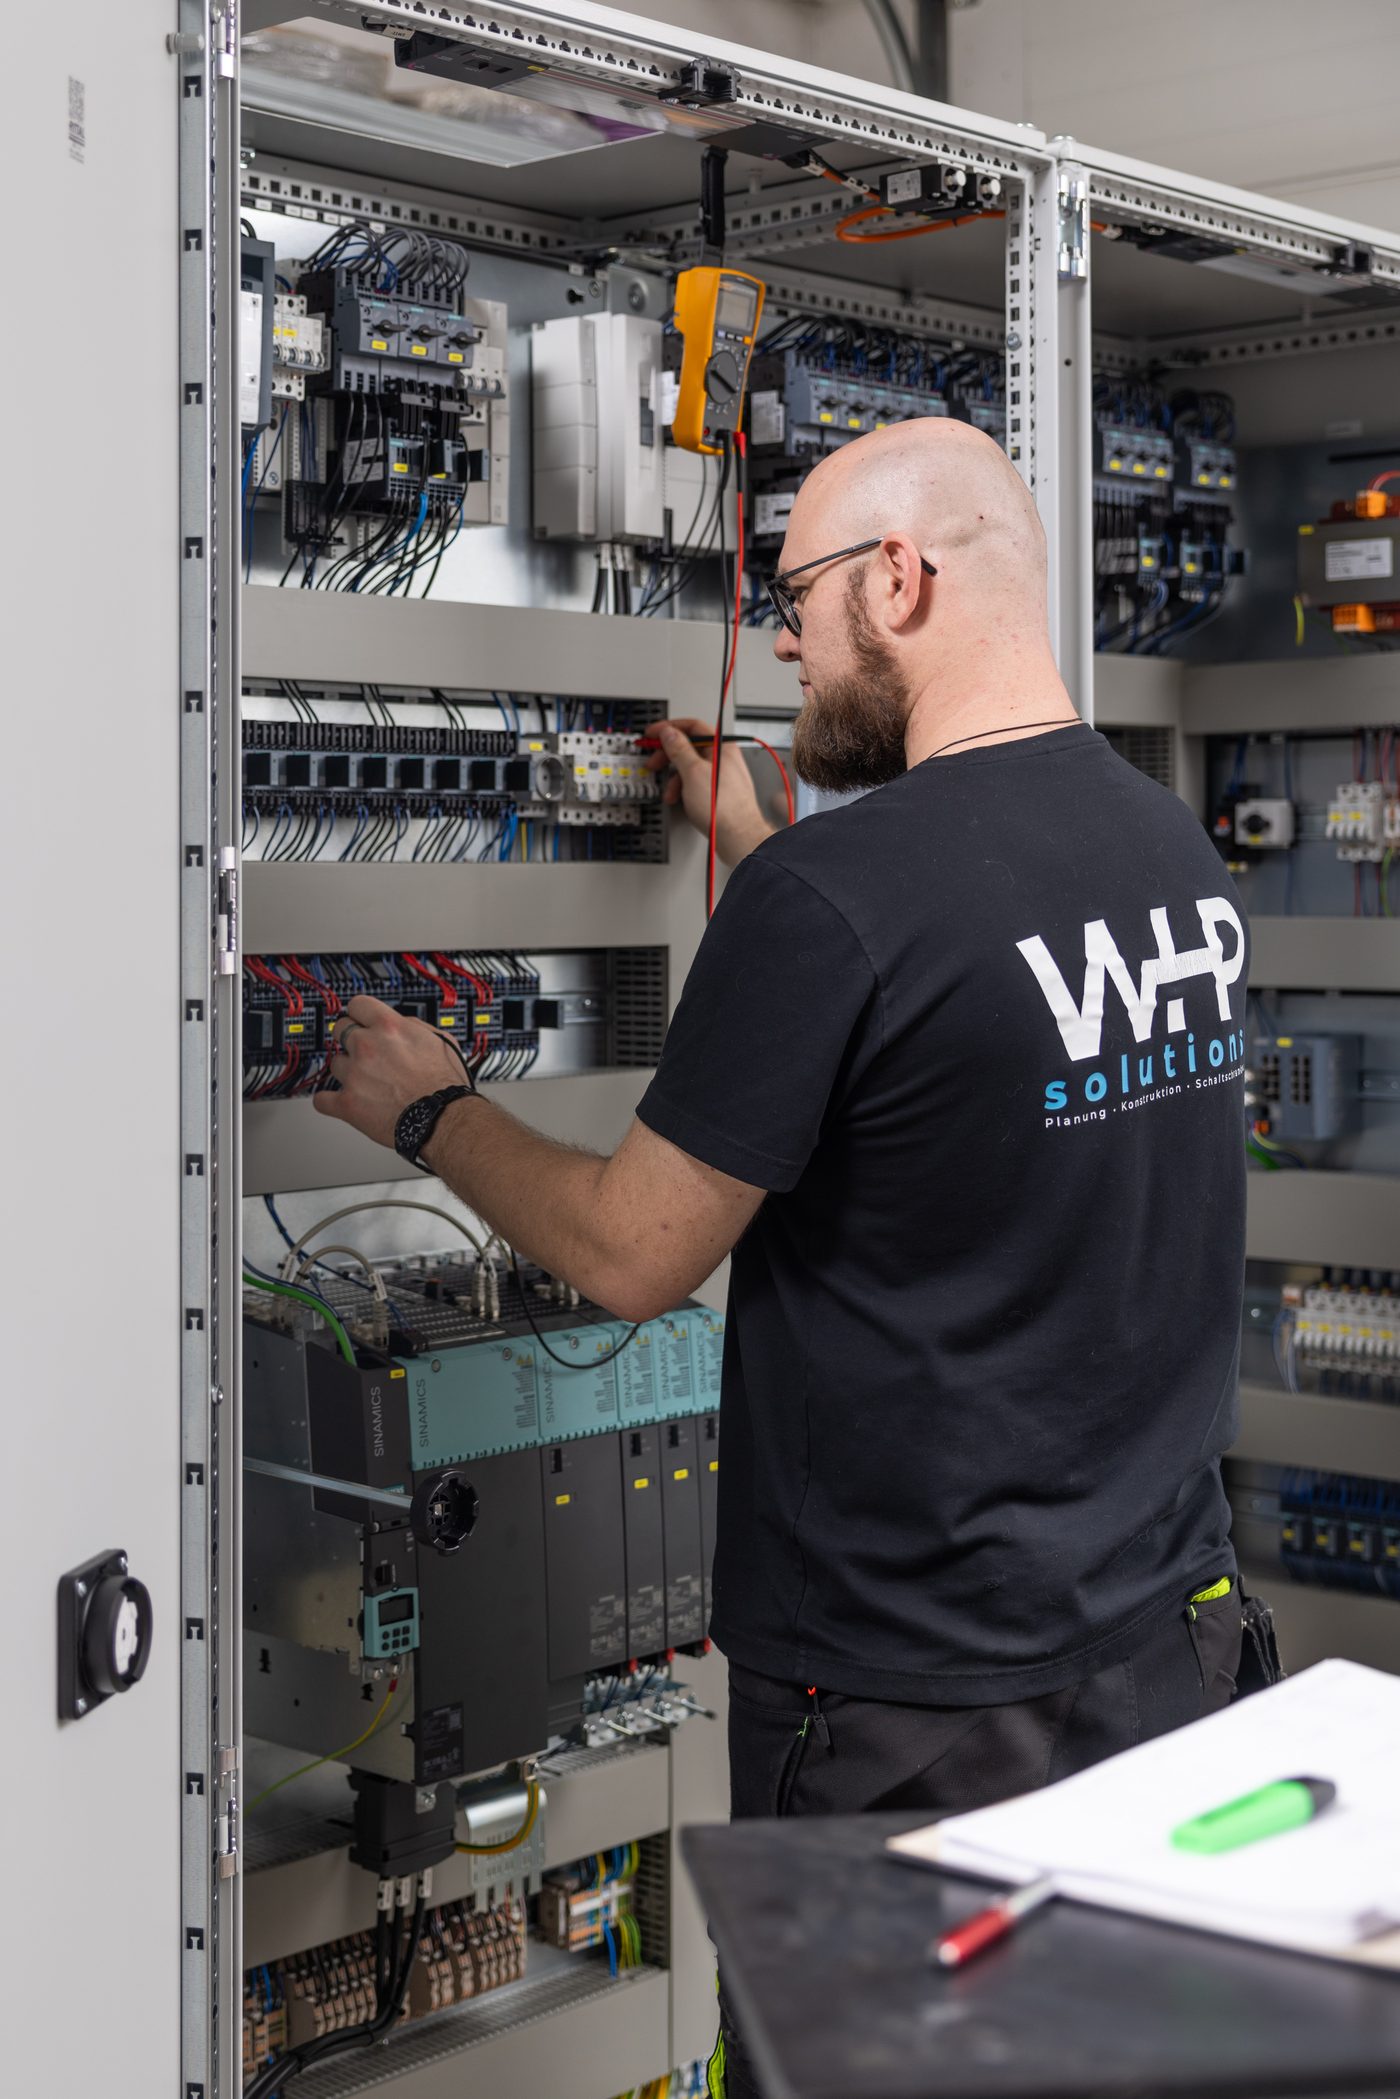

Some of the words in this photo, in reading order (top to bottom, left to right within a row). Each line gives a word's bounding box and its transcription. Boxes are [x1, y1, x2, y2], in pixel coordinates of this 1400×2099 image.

[1016, 897, 1244, 1061] WHP
[1045, 1108, 1106, 1128] Planung
[1121, 1085, 1182, 1111] Konstruktion
[543, 1357, 555, 1424] SINAMICS
[659, 1337, 671, 1400] SINAMICS
[371, 1386, 384, 1457] SINAMICS
[416, 1378, 429, 1448] SINAMICS
